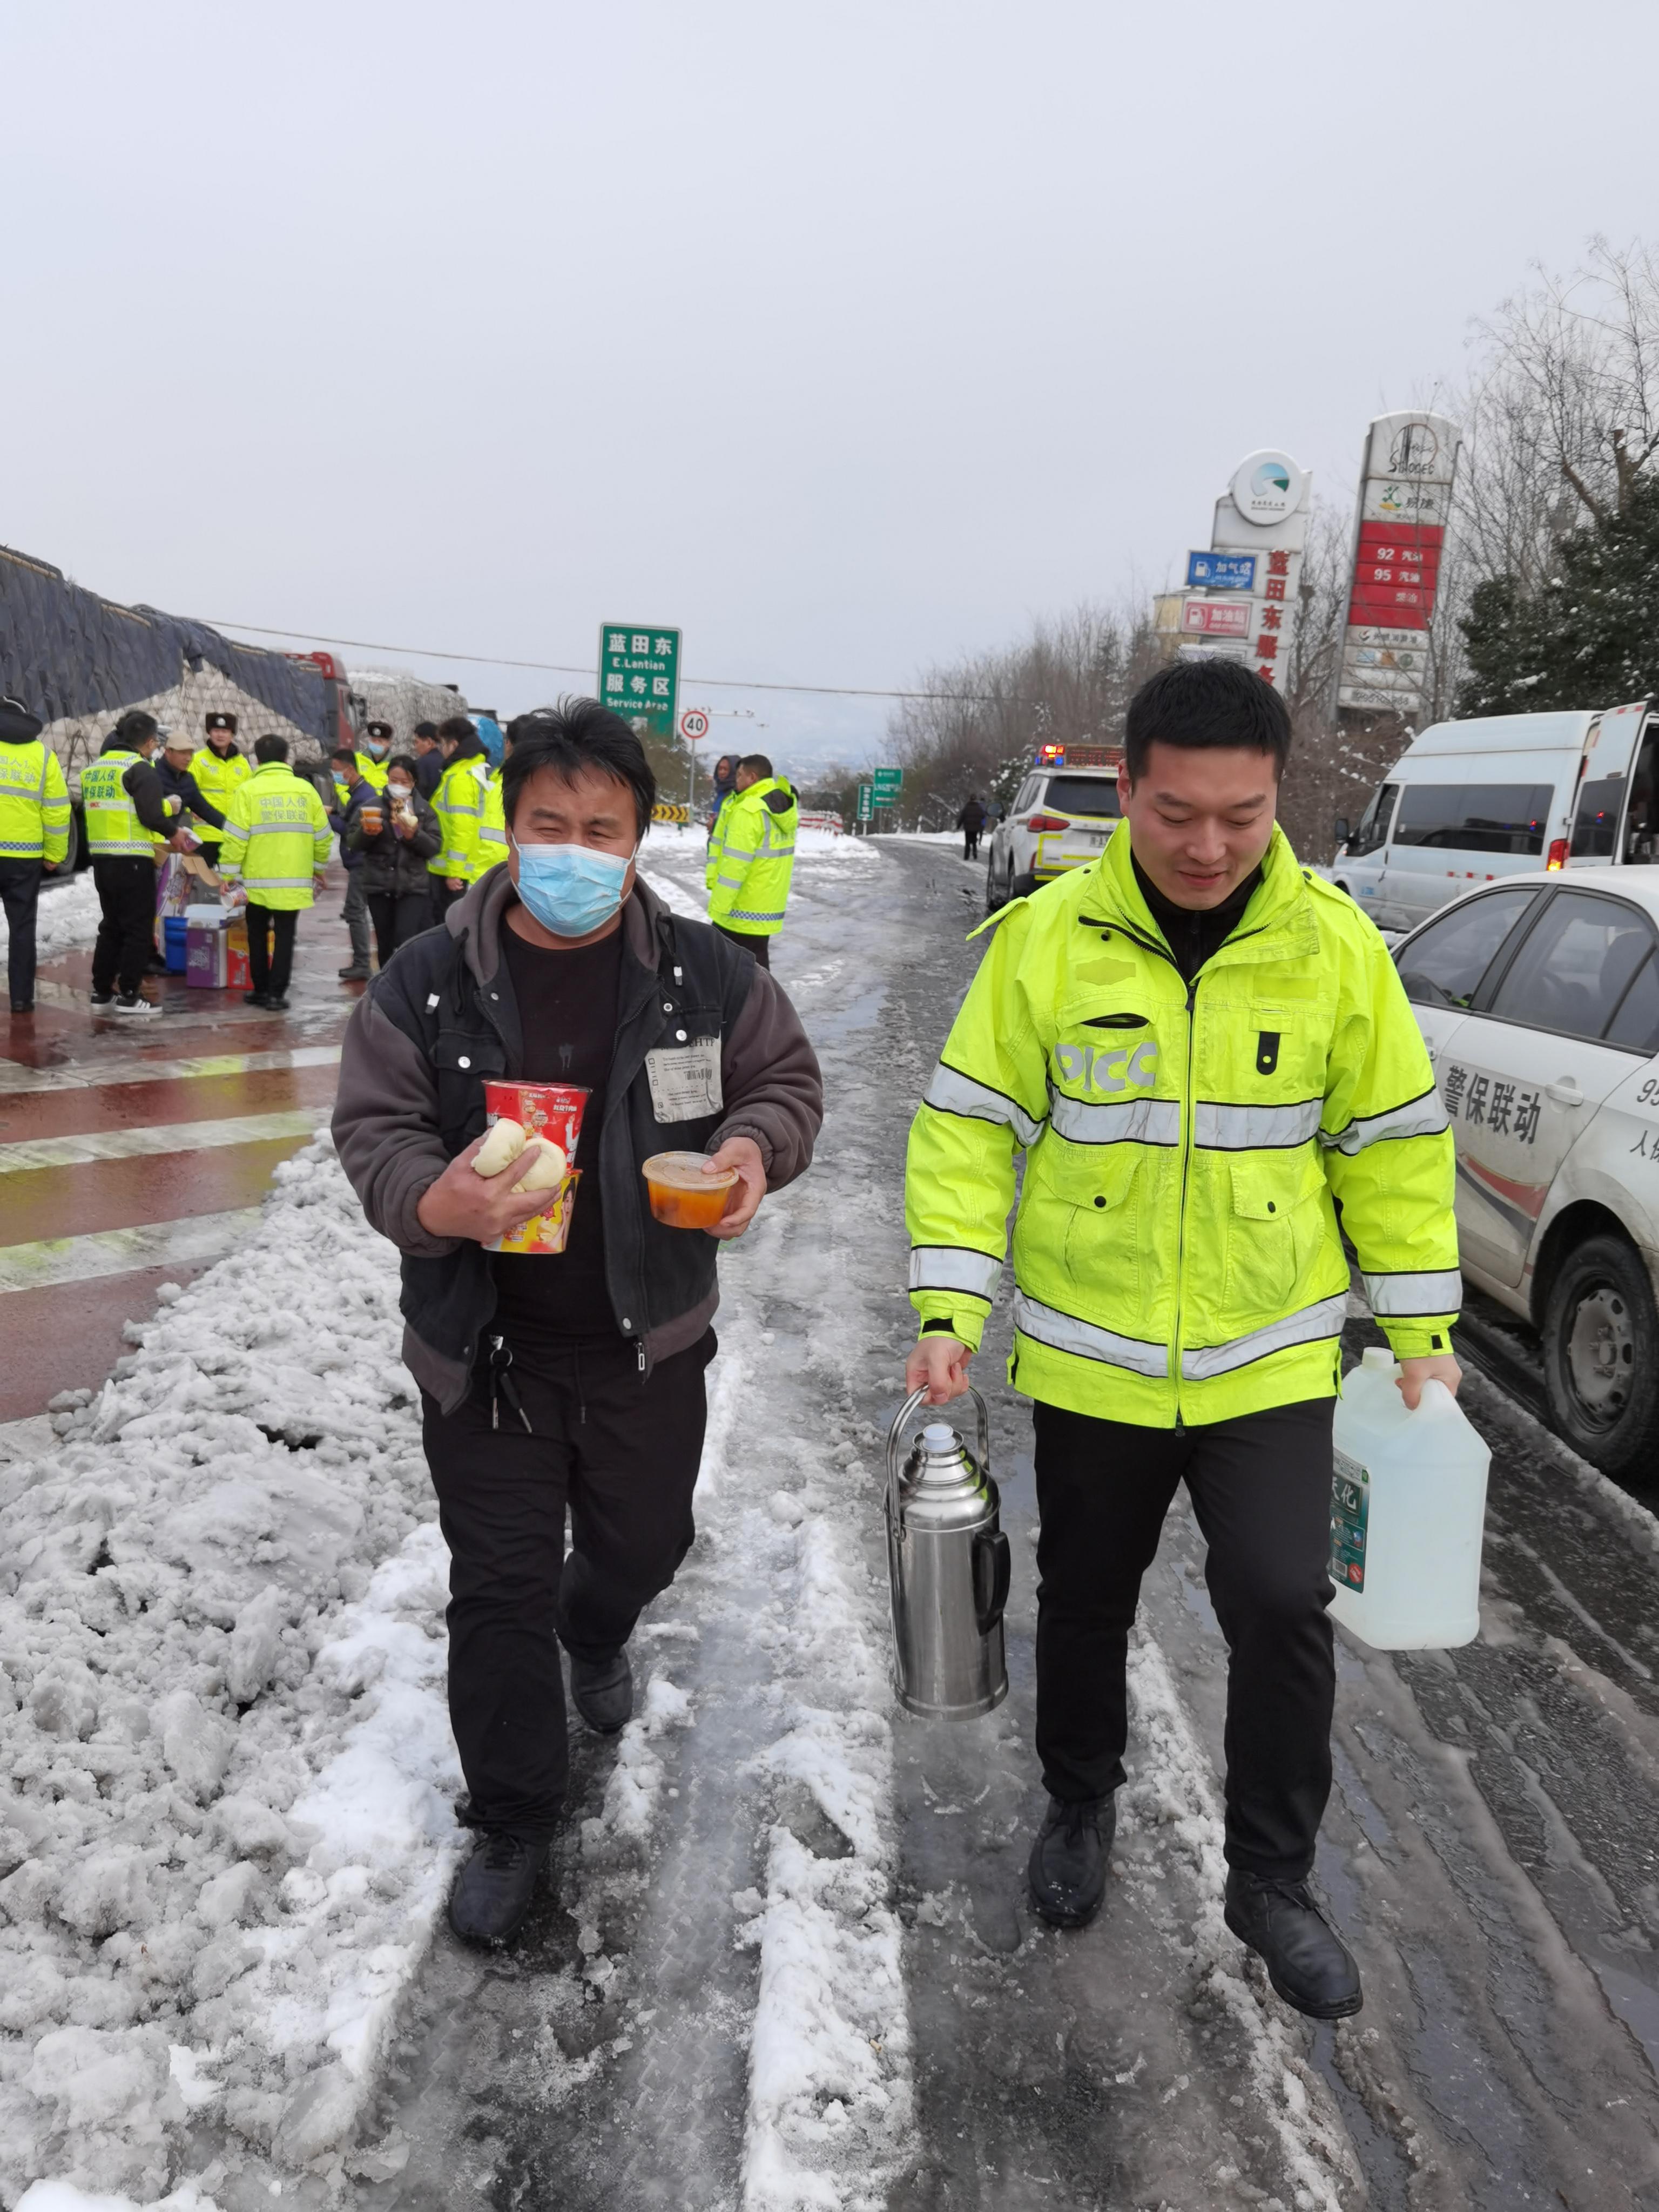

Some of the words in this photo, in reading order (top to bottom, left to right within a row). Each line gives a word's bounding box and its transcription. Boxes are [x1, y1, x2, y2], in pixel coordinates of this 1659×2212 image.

[1377, 548, 1394, 560] 92
[1402, 551, 1422, 562] 汽油
[1374, 569, 1392, 581] 95
[1399, 571, 1420, 583] 汽油
[608, 633, 672, 656] 蓝田东
[606, 672, 670, 696] 服务区
[606, 697, 643, 709] Service
[644, 700, 668, 711] Area
[687, 717, 703, 731] 40
[85, 770, 116, 782] 中国人保
[260, 797, 307, 808] 中国人保
[261, 810, 307, 821] 警保联动
[1055, 1041, 1158, 1092] PICC
[1445, 1065, 1541, 1144] 警保联动
